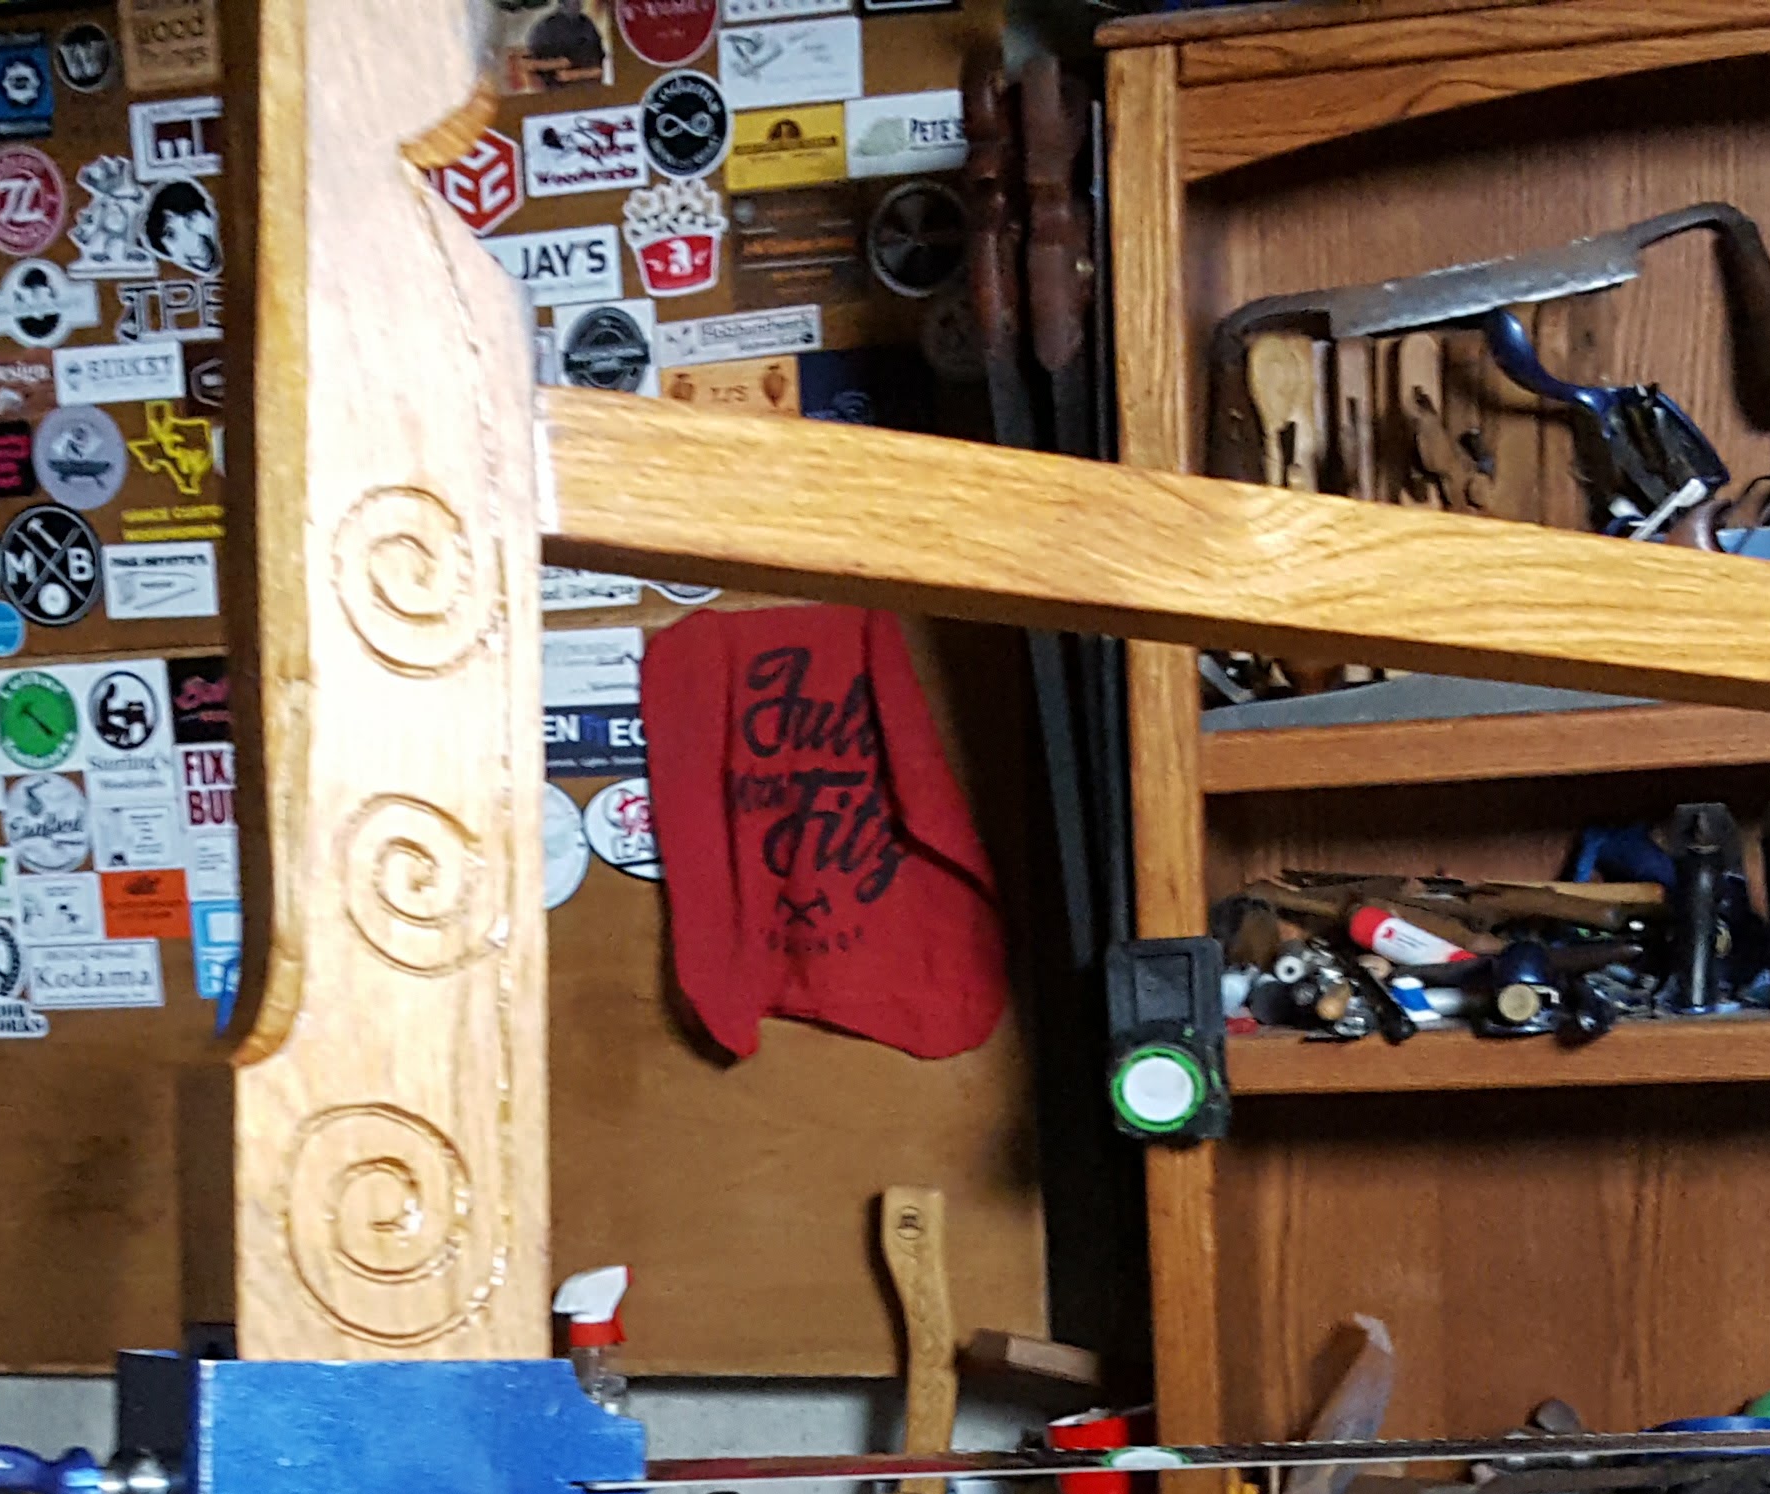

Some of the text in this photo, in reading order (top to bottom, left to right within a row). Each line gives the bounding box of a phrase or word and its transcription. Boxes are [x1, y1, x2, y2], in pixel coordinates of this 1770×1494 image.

[518, 239, 608, 281] JAY'S
[4, 546, 95, 585] M B
[183, 749, 230, 787] FIX
[188, 788, 237, 827] BU
[33, 964, 150, 988] Kodama
